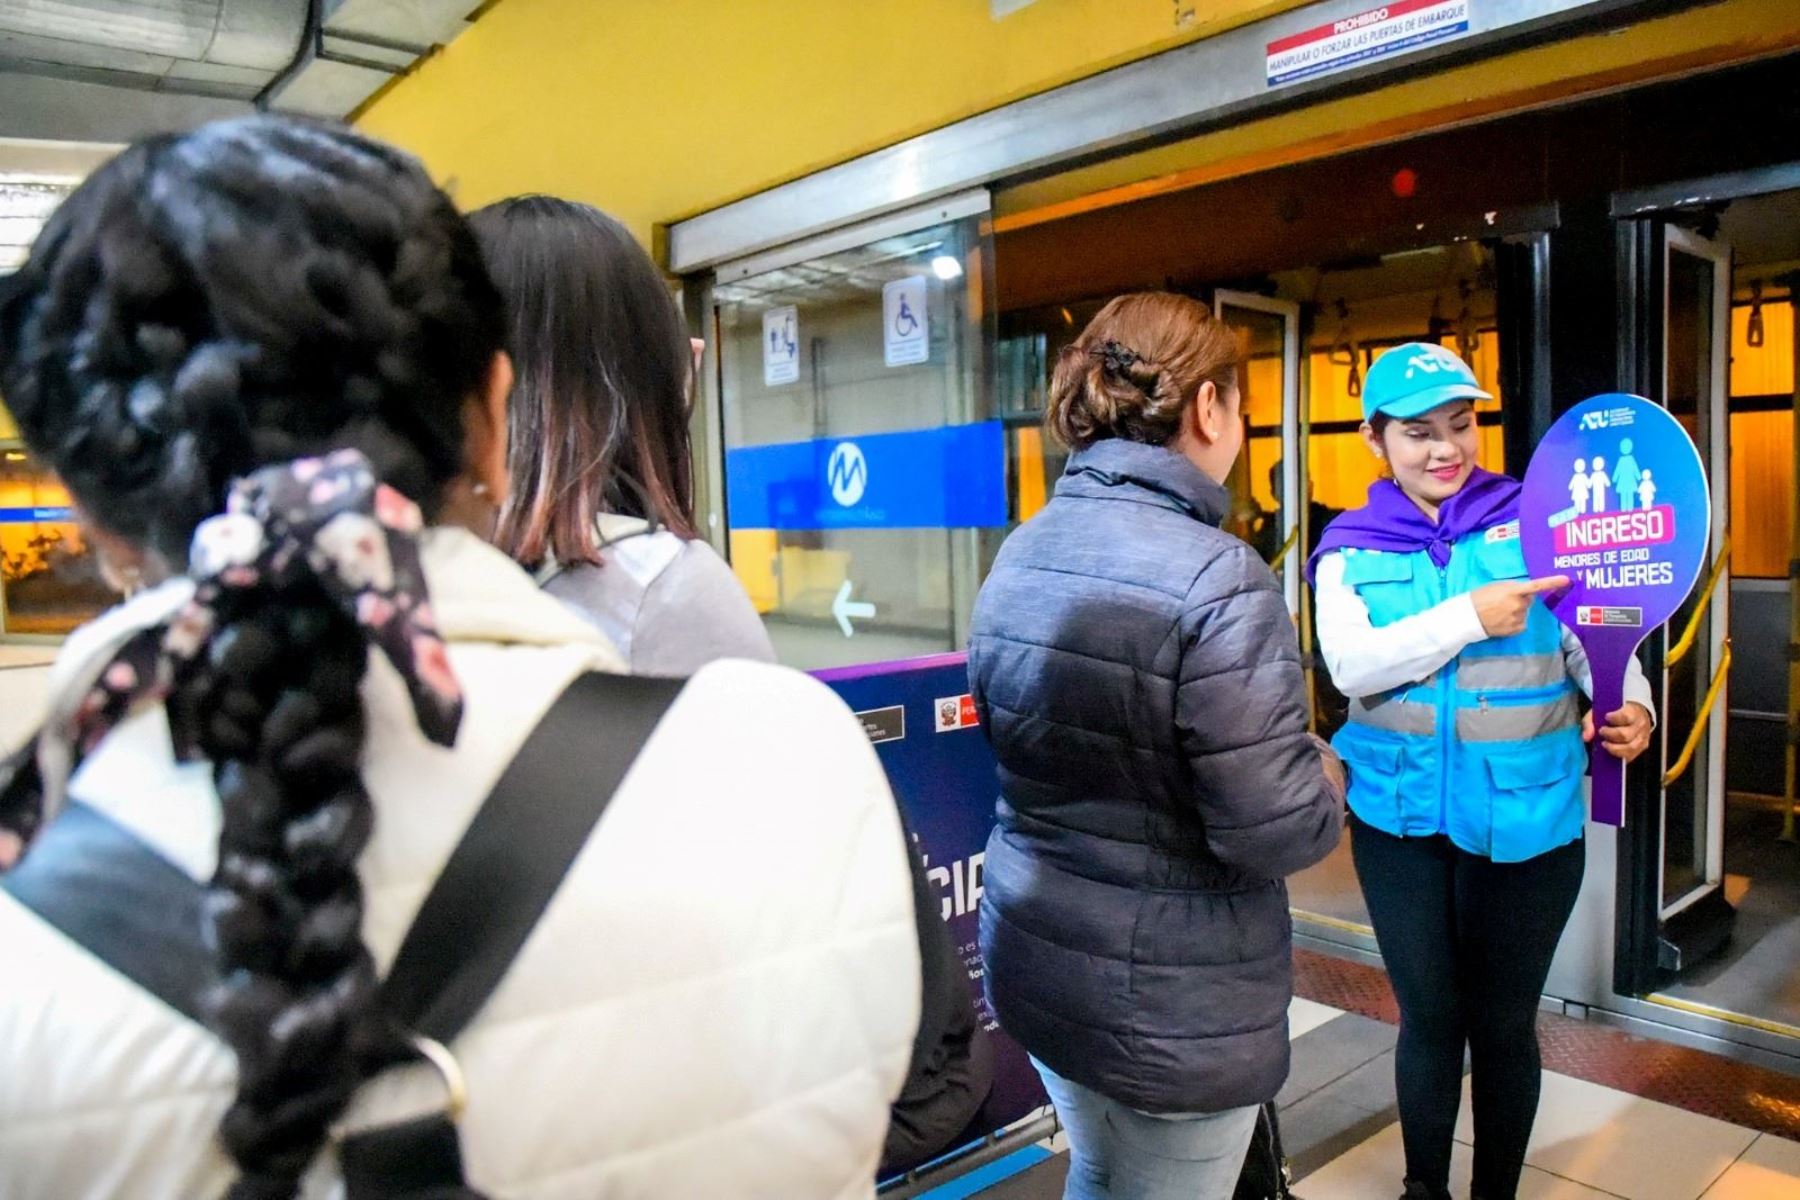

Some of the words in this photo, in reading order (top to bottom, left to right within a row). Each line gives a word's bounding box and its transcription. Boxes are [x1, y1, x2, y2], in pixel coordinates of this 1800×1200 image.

[1334, 8, 1389, 34] PROHIBIDO
[1269, 51, 1311, 71] MANIPULAR
[1312, 47, 1320, 58] O
[1321, 38, 1352, 58] FORZAR
[1353, 33, 1368, 48] LAS
[1369, 25, 1404, 43] PUERTAS
[1404, 19, 1416, 31] DE
[1417, 5, 1466, 29] EMBARQUE
[1565, 511, 1664, 549] INGRESO
[1554, 551, 1601, 569] MENORES
[1604, 549, 1617, 563] DE
[1620, 548, 1649, 563] EDAD
[1576, 570, 1584, 581] Y
[1585, 562, 1674, 590] MUJERES
